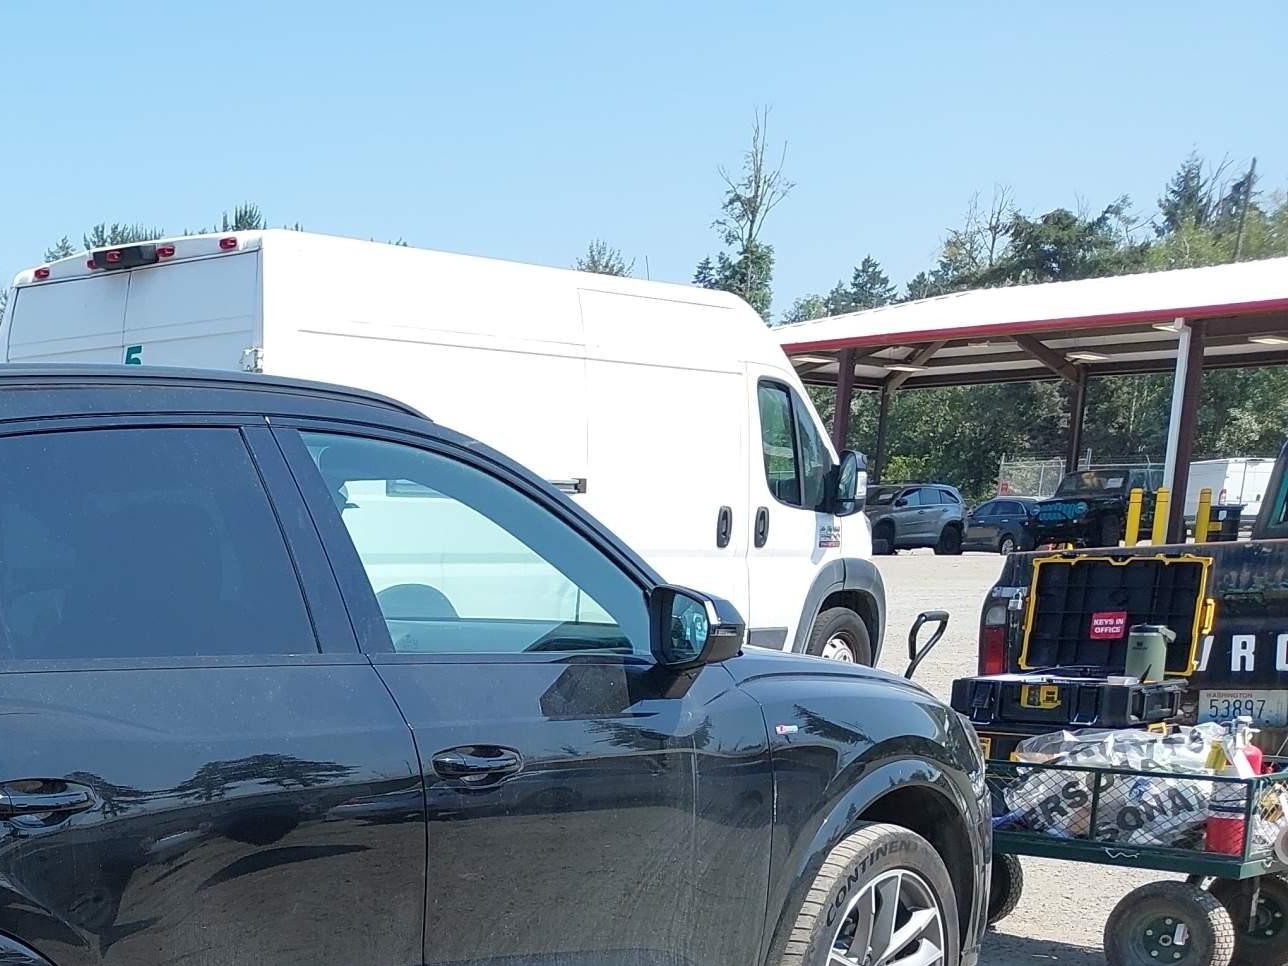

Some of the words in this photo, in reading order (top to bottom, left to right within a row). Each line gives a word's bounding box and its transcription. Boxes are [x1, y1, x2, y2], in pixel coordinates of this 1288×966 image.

[1093, 618, 1114, 626] KEYS
[1094, 626, 1121, 634] OFFICE
[1209, 699, 1266, 719] 53897
